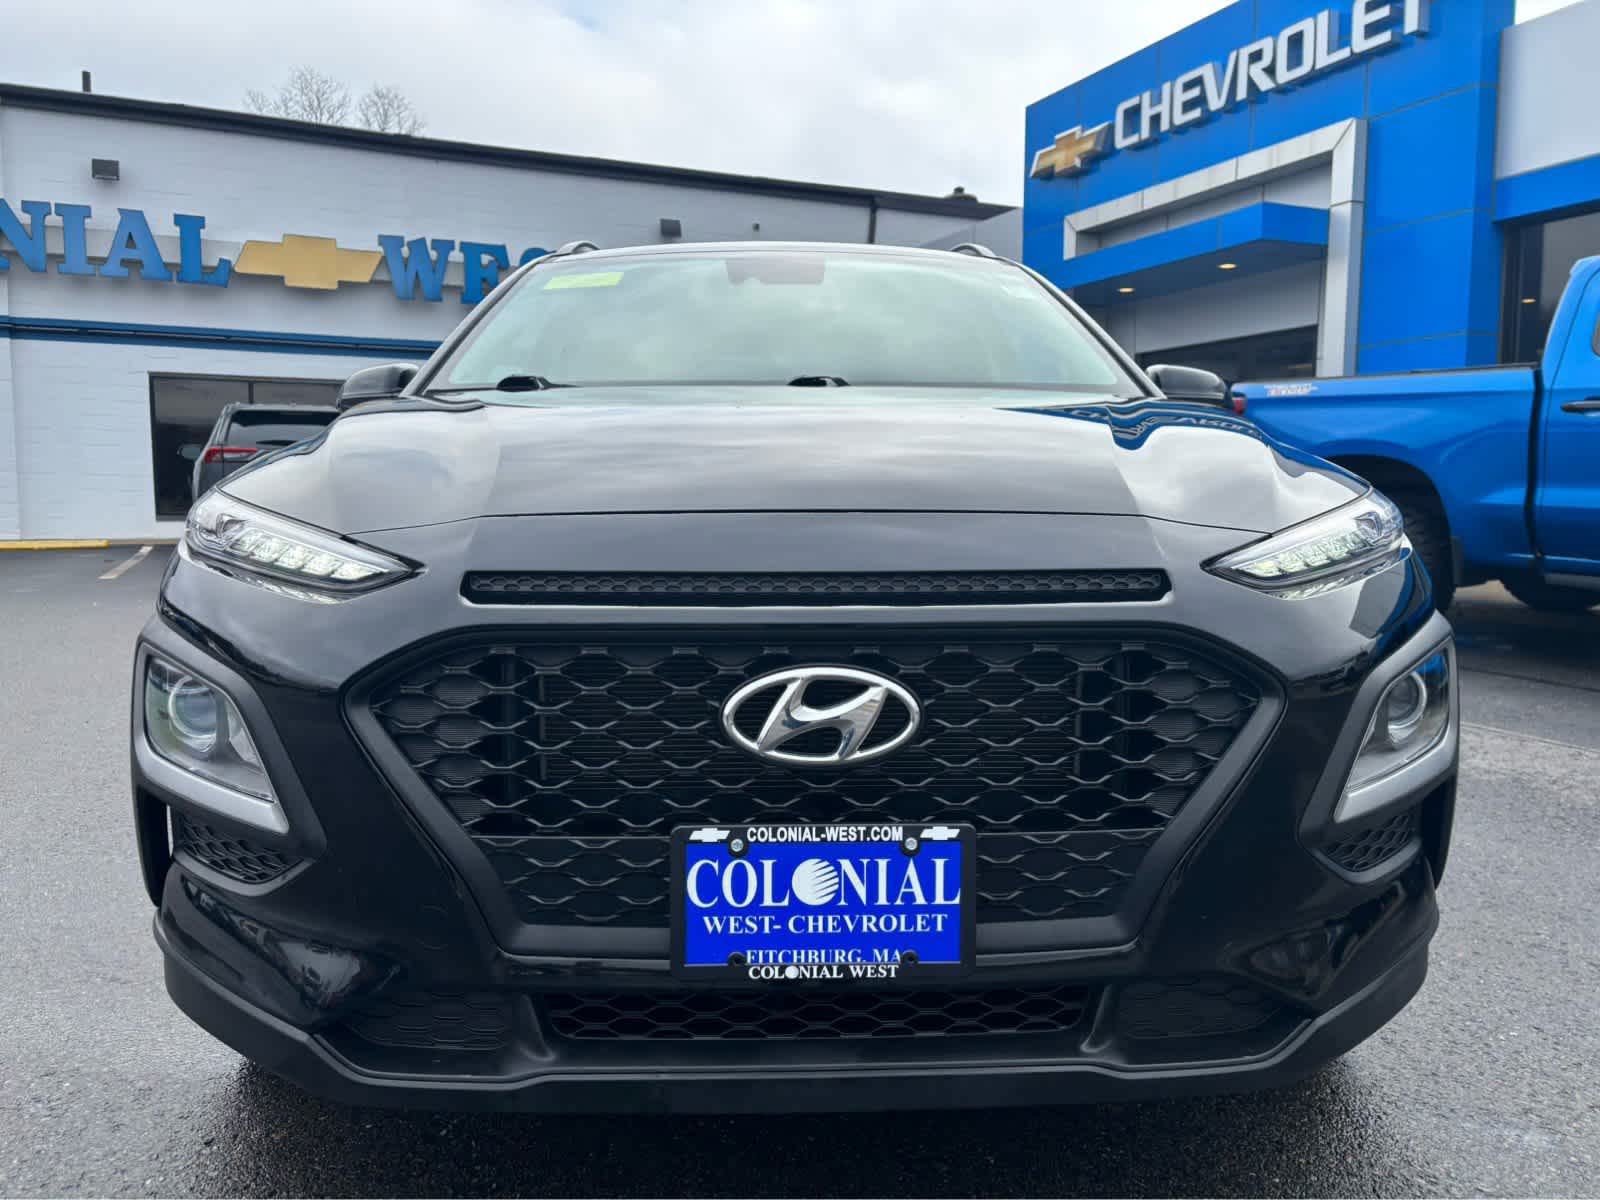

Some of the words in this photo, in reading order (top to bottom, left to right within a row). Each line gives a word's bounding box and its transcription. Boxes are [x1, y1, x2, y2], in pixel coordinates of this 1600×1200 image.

[378, 234, 546, 304] WE
[746, 826, 903, 843] COLONIAL-WEST.COM
[686, 857, 961, 908] COLONIAL
[787, 913, 948, 933] CHEVROLET
[873, 948, 901, 963] MA
[849, 964, 900, 978] WEST
